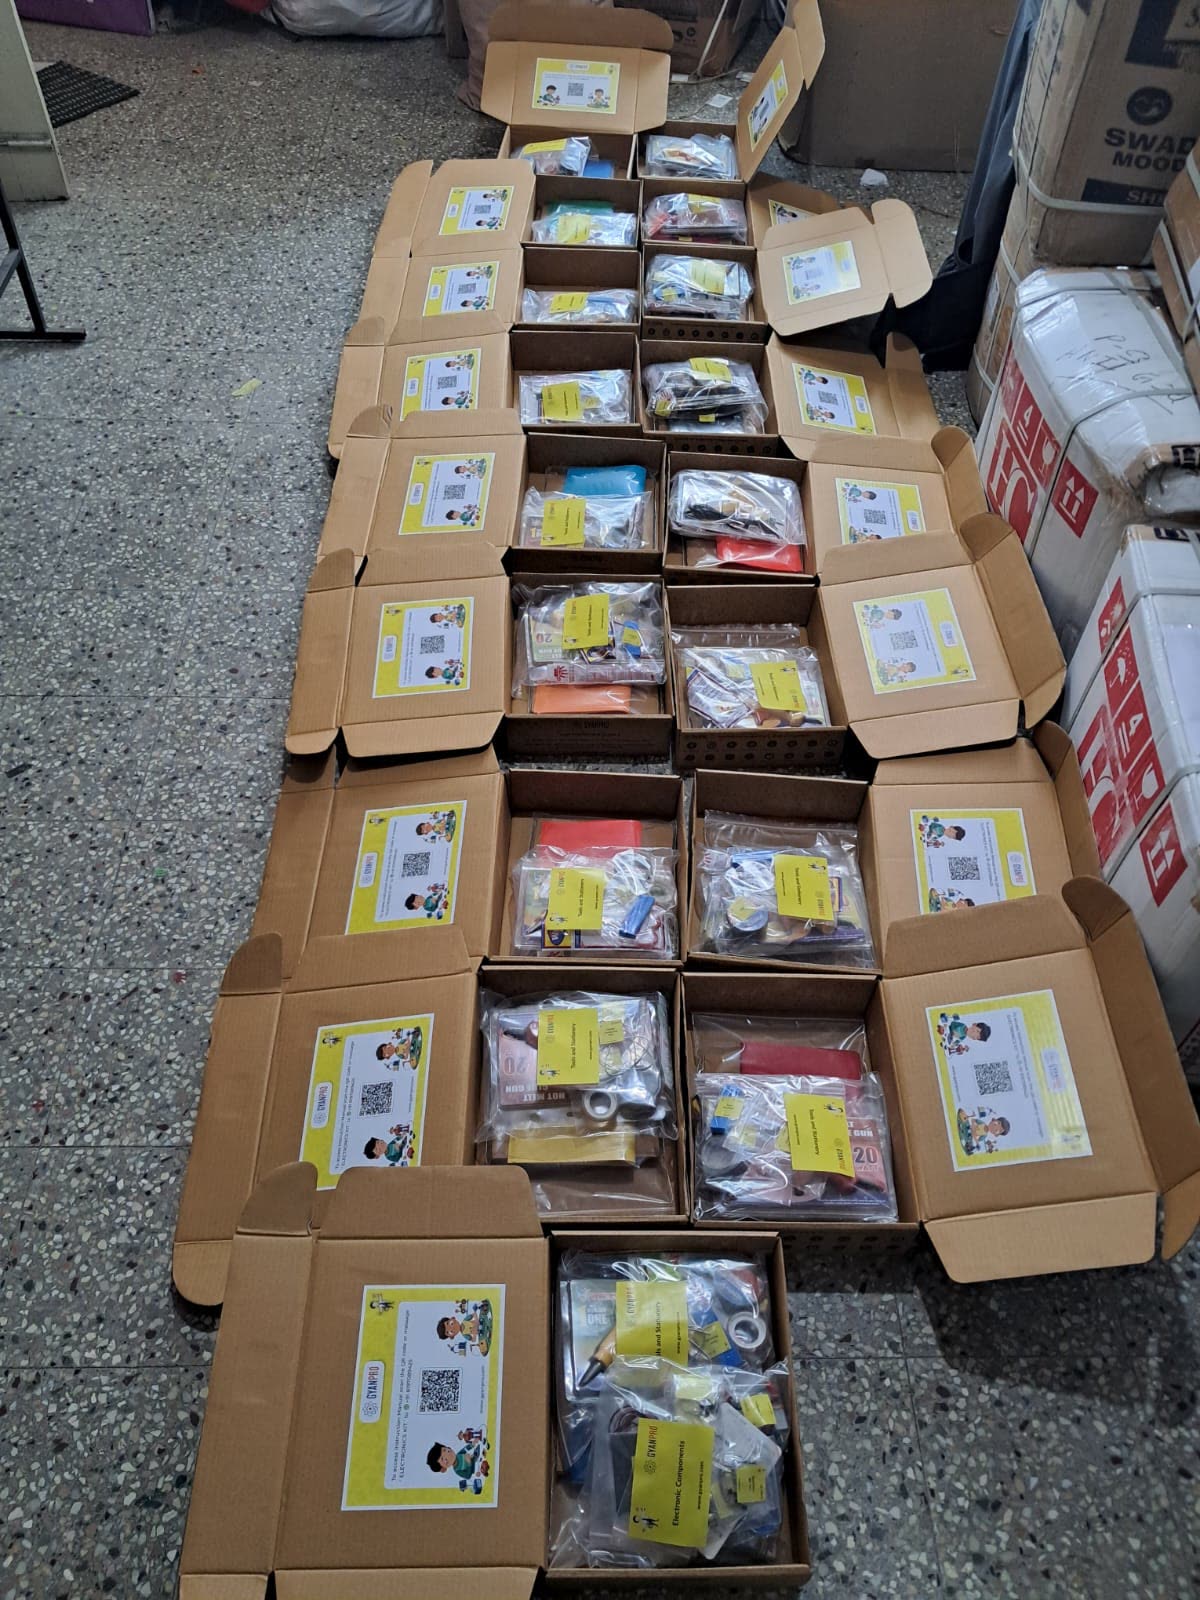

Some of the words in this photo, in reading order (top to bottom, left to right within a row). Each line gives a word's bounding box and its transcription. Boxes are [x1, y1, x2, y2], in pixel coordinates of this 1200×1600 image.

[853, 1146, 878, 1164] 20
[366, 1366, 380, 1399] GYANPRO
[646, 1425, 658, 1458] GYANPRO
[674, 1440, 686, 1488] Components
[672, 1489, 682, 1526] Electronic
